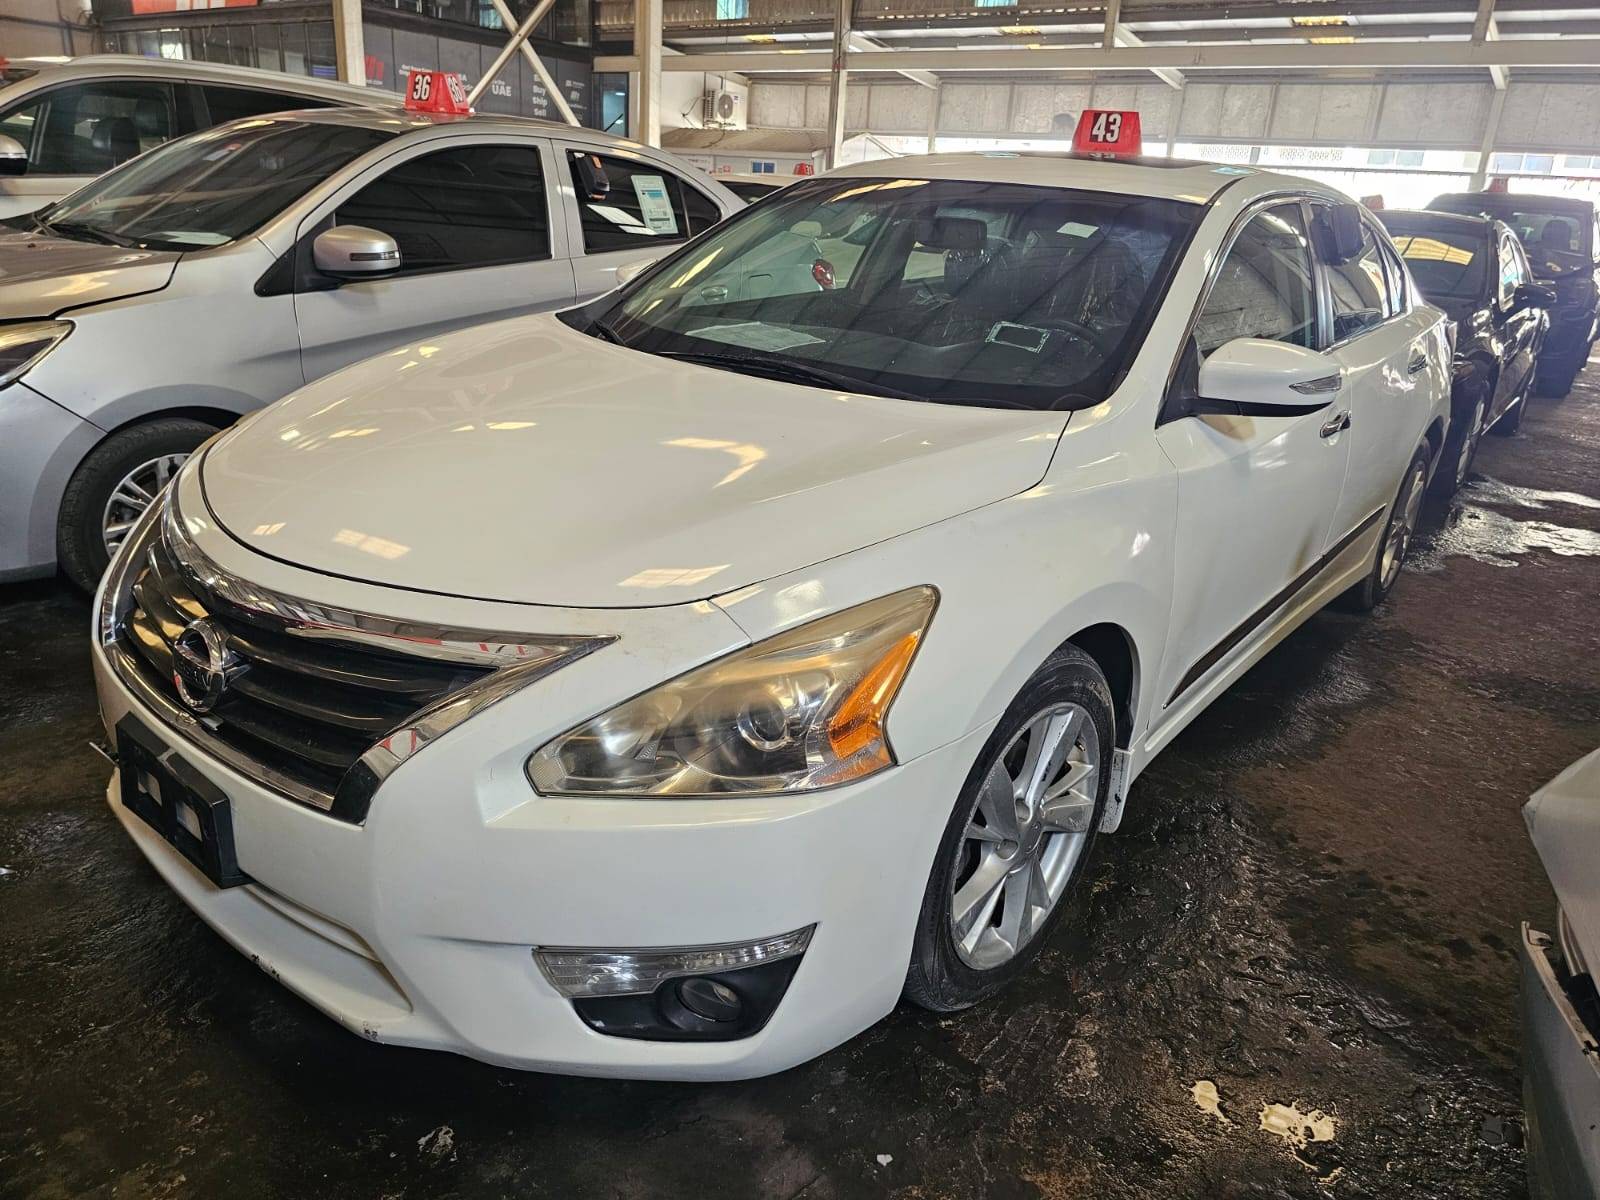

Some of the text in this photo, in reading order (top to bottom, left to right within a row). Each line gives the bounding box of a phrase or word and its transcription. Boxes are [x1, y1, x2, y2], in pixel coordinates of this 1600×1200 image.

[413, 74, 432, 100] 36
[492, 85, 512, 97] UAE
[533, 85, 546, 97] Buy
[532, 96, 548, 108] Ship
[534, 108, 547, 117] Sell
[1092, 113, 1122, 142] 43
